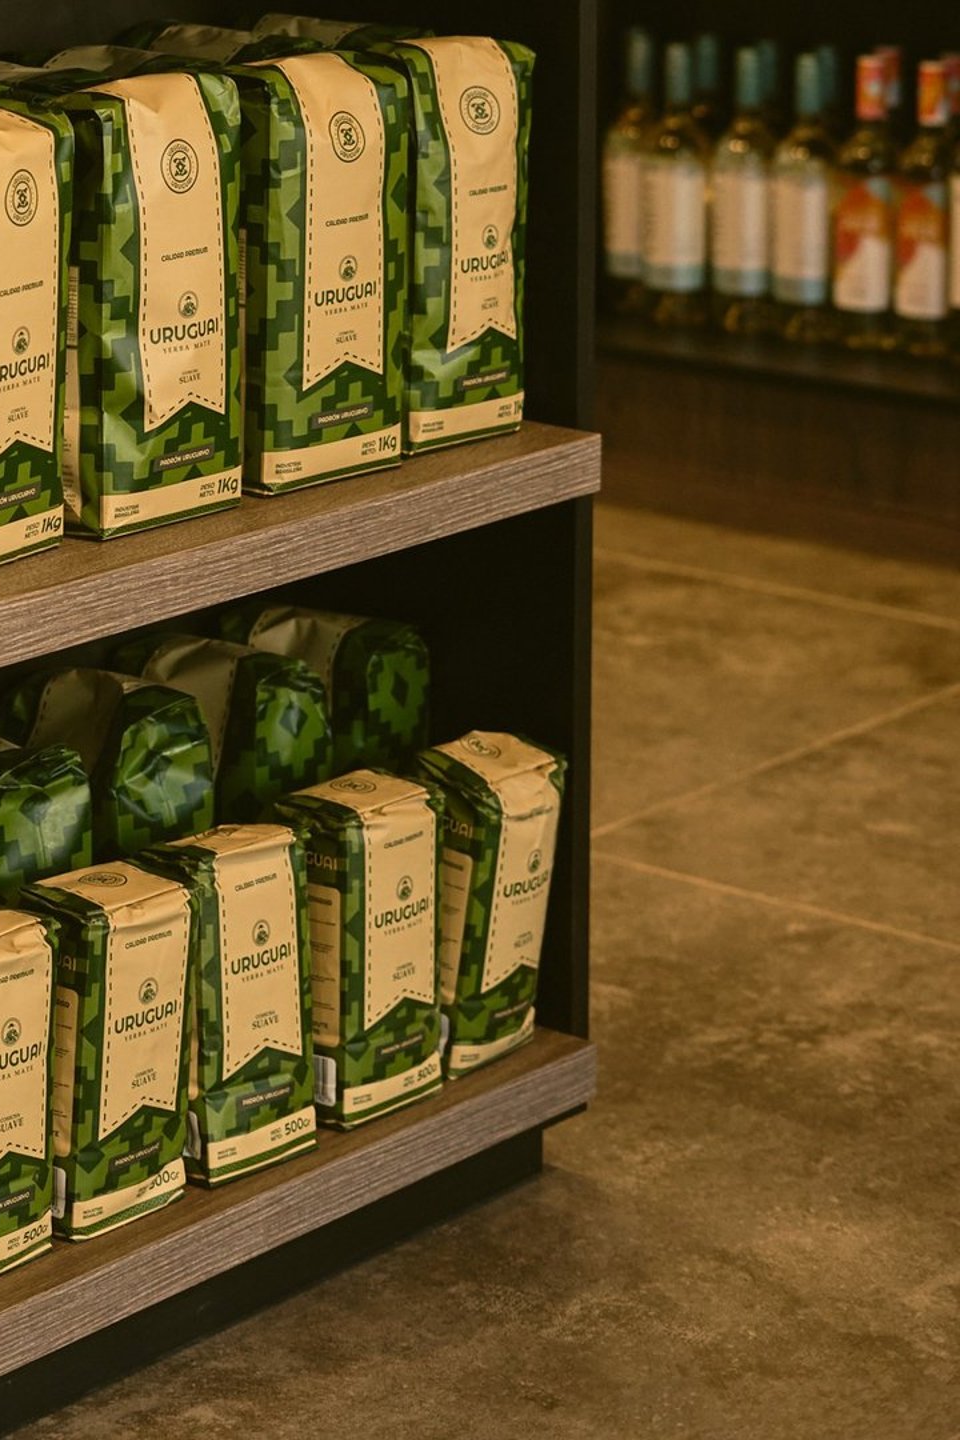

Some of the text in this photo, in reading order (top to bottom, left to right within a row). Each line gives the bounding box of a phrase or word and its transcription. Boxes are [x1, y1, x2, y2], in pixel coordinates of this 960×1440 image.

[325, 218, 347, 227] CALIDAD
[161, 252, 184, 262] CALIDAD
[0, 287, 20, 298] CALIDAD
[314, 280, 377, 308] URUGUAI
[150, 317, 219, 345] URUGUAI
[378, 434, 397, 452] 1Kg
[217, 476, 239, 495] 1Kg
[41, 515, 62, 534] 1Kg
[374, 896, 429, 928] URUGUAI
[124, 937, 147, 950] CALIDAD
[231, 942, 292, 975] URUGUAI
[114, 999, 178, 1034] URUGUAI
